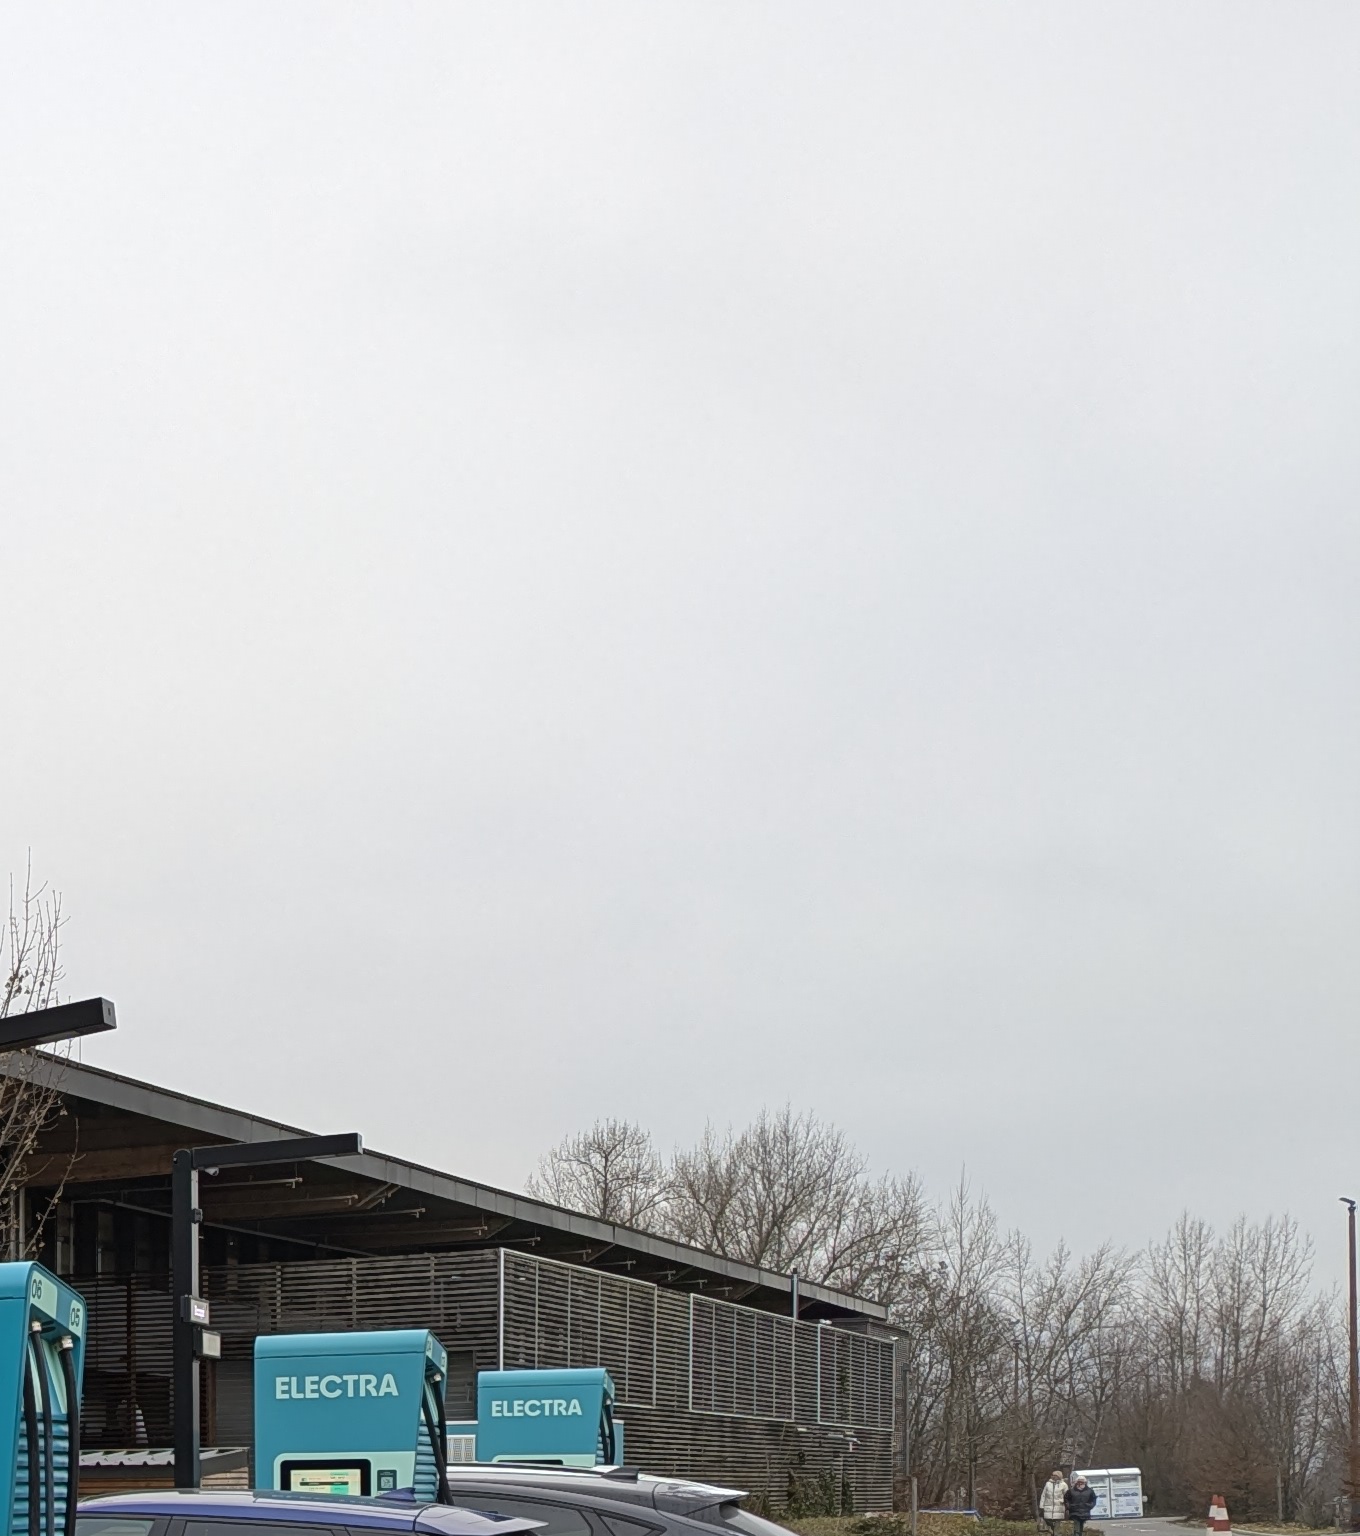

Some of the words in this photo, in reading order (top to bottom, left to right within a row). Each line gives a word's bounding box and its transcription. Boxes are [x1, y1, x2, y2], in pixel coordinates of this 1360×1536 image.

[31, 1279, 42, 1299] 06
[70, 1307, 81, 1328] 05
[275, 1373, 398, 1400] ELECTRA
[491, 1398, 582, 1418] ELECTRA
